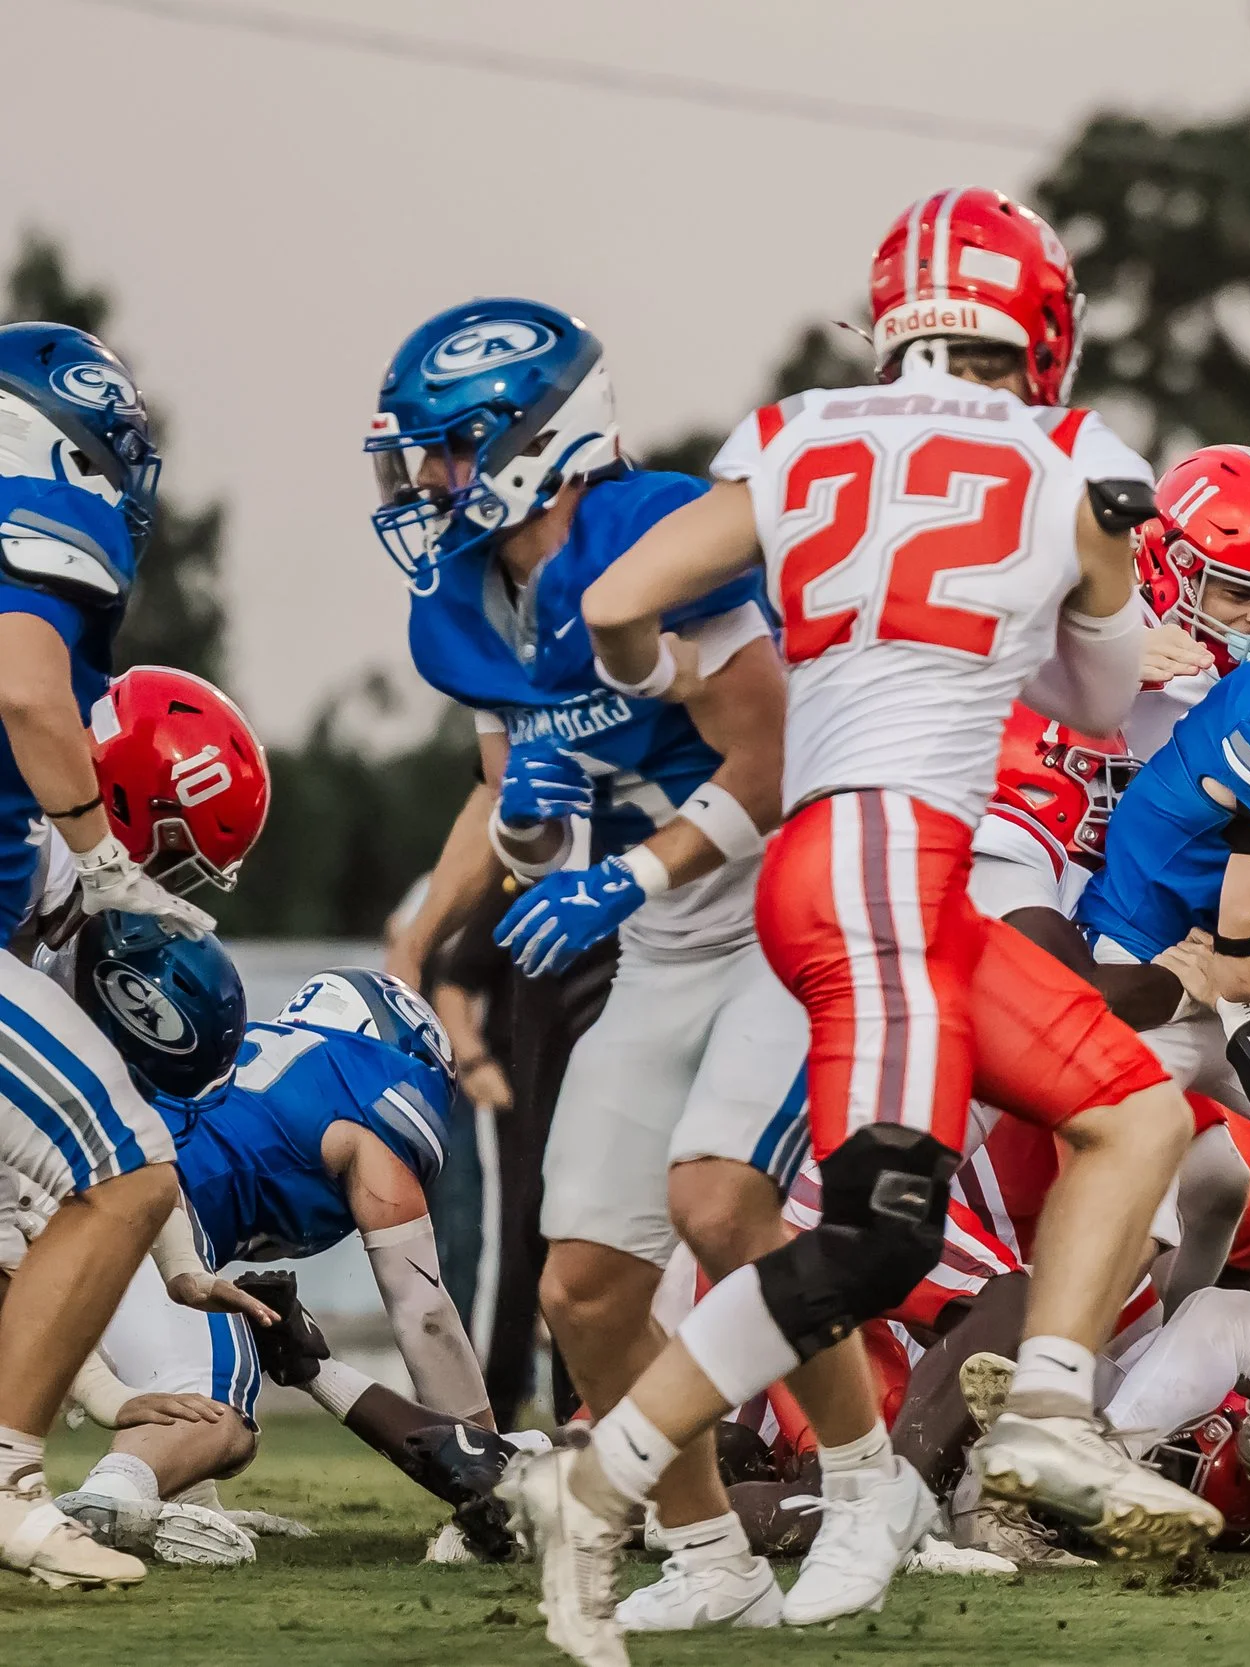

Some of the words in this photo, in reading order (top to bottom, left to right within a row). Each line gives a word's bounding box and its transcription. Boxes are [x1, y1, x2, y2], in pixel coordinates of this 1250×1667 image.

[443, 330, 522, 361] CA
[884, 306, 980, 340] Riddell
[71, 366, 130, 407] CA
[1168, 475, 1221, 529] 11
[778, 428, 1044, 664] 22
[170, 744, 233, 808] 10
[117, 972, 165, 1038] CA
